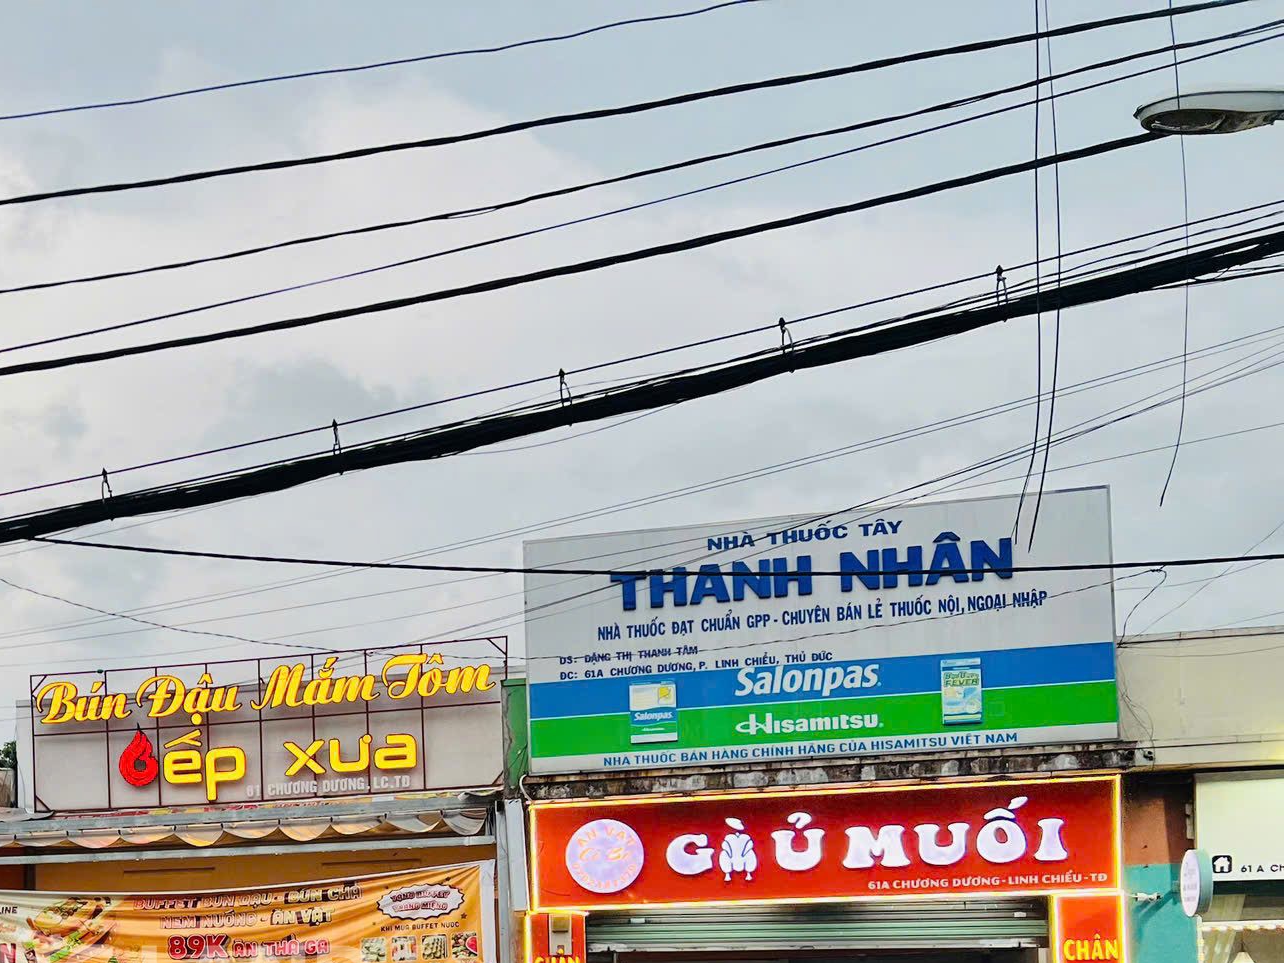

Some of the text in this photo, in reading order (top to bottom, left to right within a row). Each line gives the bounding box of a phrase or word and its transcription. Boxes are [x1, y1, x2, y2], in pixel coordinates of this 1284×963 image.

[707, 518, 903, 551] NHÀ THUỐC TÂY
[610, 531, 1013, 612] THANH NHÂN
[597, 622, 621, 641] NHÀ
[626, 616, 666, 638] THUỐC
[671, 619, 694, 638] ĐẠT
[701, 609, 741, 632] CHUẨN
[746, 612, 771, 629] GPP
[782, 604, 830, 626] CHUYÊN
[836, 601, 862, 621] BÁN
[868, 598, 883, 619] LẺ
[891, 594, 931, 617] THUỐC
[967, 592, 1007, 613] NGOẠI
[1012, 588, 1048, 608] NHẬP
[584, 669, 604, 679] 61A
[610, 664, 652, 677] CHƯƠNG
[715, 659, 739, 669] LINH
[784, 650, 806, 663] THỦ
[811, 651, 833, 662] ĐỨC
[638, 648, 672, 660] THANH
[676, 645, 698, 656] TÂM
[36, 652, 497, 726] Bún Đậu Mắm Tôm
[282, 731, 418, 777] xưa
[871, 735, 948, 751] HISAMITSU
[985, 731, 1018, 744] NAM
[770, 811, 826, 871] Ủ
[842, 796, 1069, 869] MUỐI
[1240, 864, 1265, 873] 61 A
[867, 880, 890, 890] 61A
[412, 922, 438, 931] BUFFET
[167, 933, 229, 960] 89K
[1063, 933, 1119, 961] CHÂN
